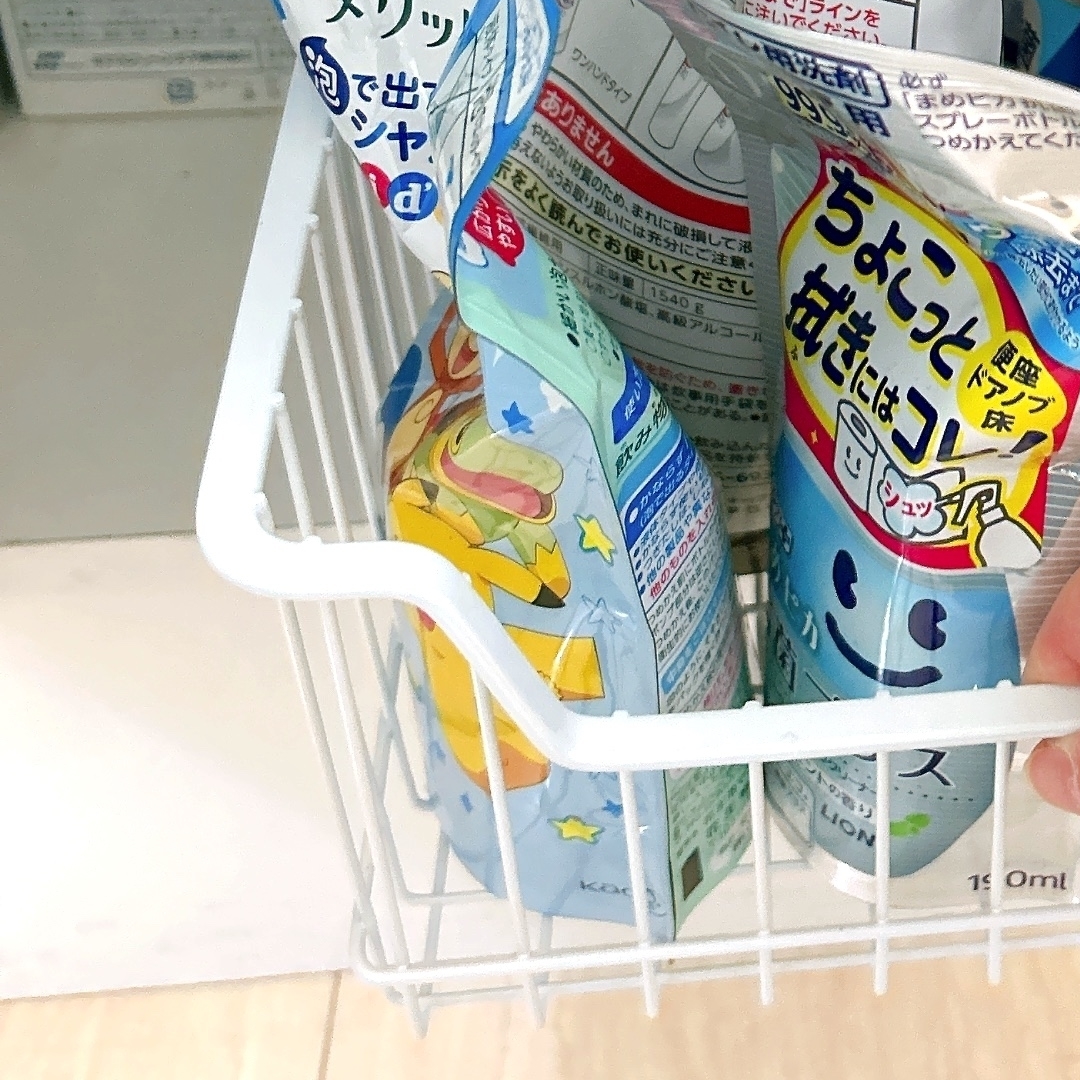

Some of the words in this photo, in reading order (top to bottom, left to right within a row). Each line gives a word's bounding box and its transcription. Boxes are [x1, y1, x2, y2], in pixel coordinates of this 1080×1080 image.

[306, 44, 436, 112] 泡で出
[571, 47, 633, 105] ワンハンドタイプ
[898, 70, 948, 90] 必ず
[350, 108, 434, 164] シャ
[540, 88, 616, 168] ありません
[649, 287, 690, 309] 1540
[813, 164, 980, 382] ちょこっと
[966, 363, 1057, 416] ドアノブ
[990, 338, 1044, 389] 便座
[981, 409, 1017, 433] 床
[882, 481, 935, 519] シュッ
[820, 802, 876, 848] LION
